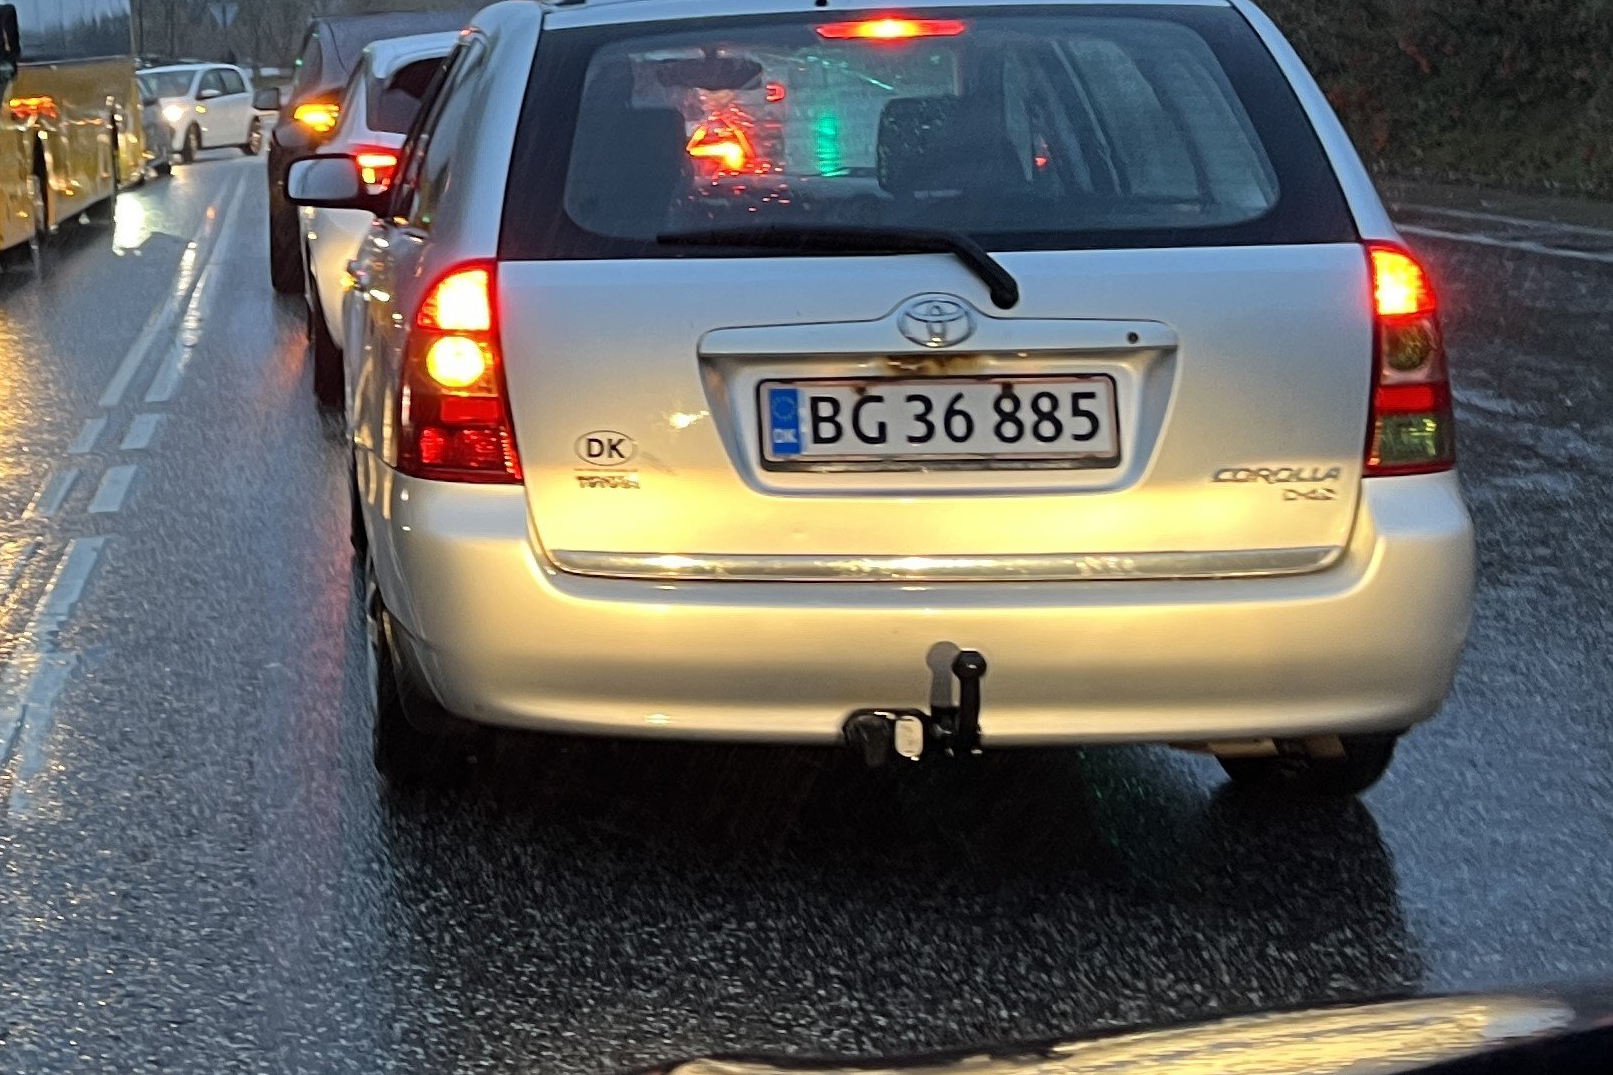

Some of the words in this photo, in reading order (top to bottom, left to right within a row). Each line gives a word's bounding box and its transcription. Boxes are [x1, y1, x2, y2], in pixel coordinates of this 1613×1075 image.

[809, 394, 887, 444] BG
[904, 392, 975, 444] 36
[992, 391, 1100, 443] 885
[586, 438, 625, 458] DK
[1211, 467, 1341, 484] COROLLA
